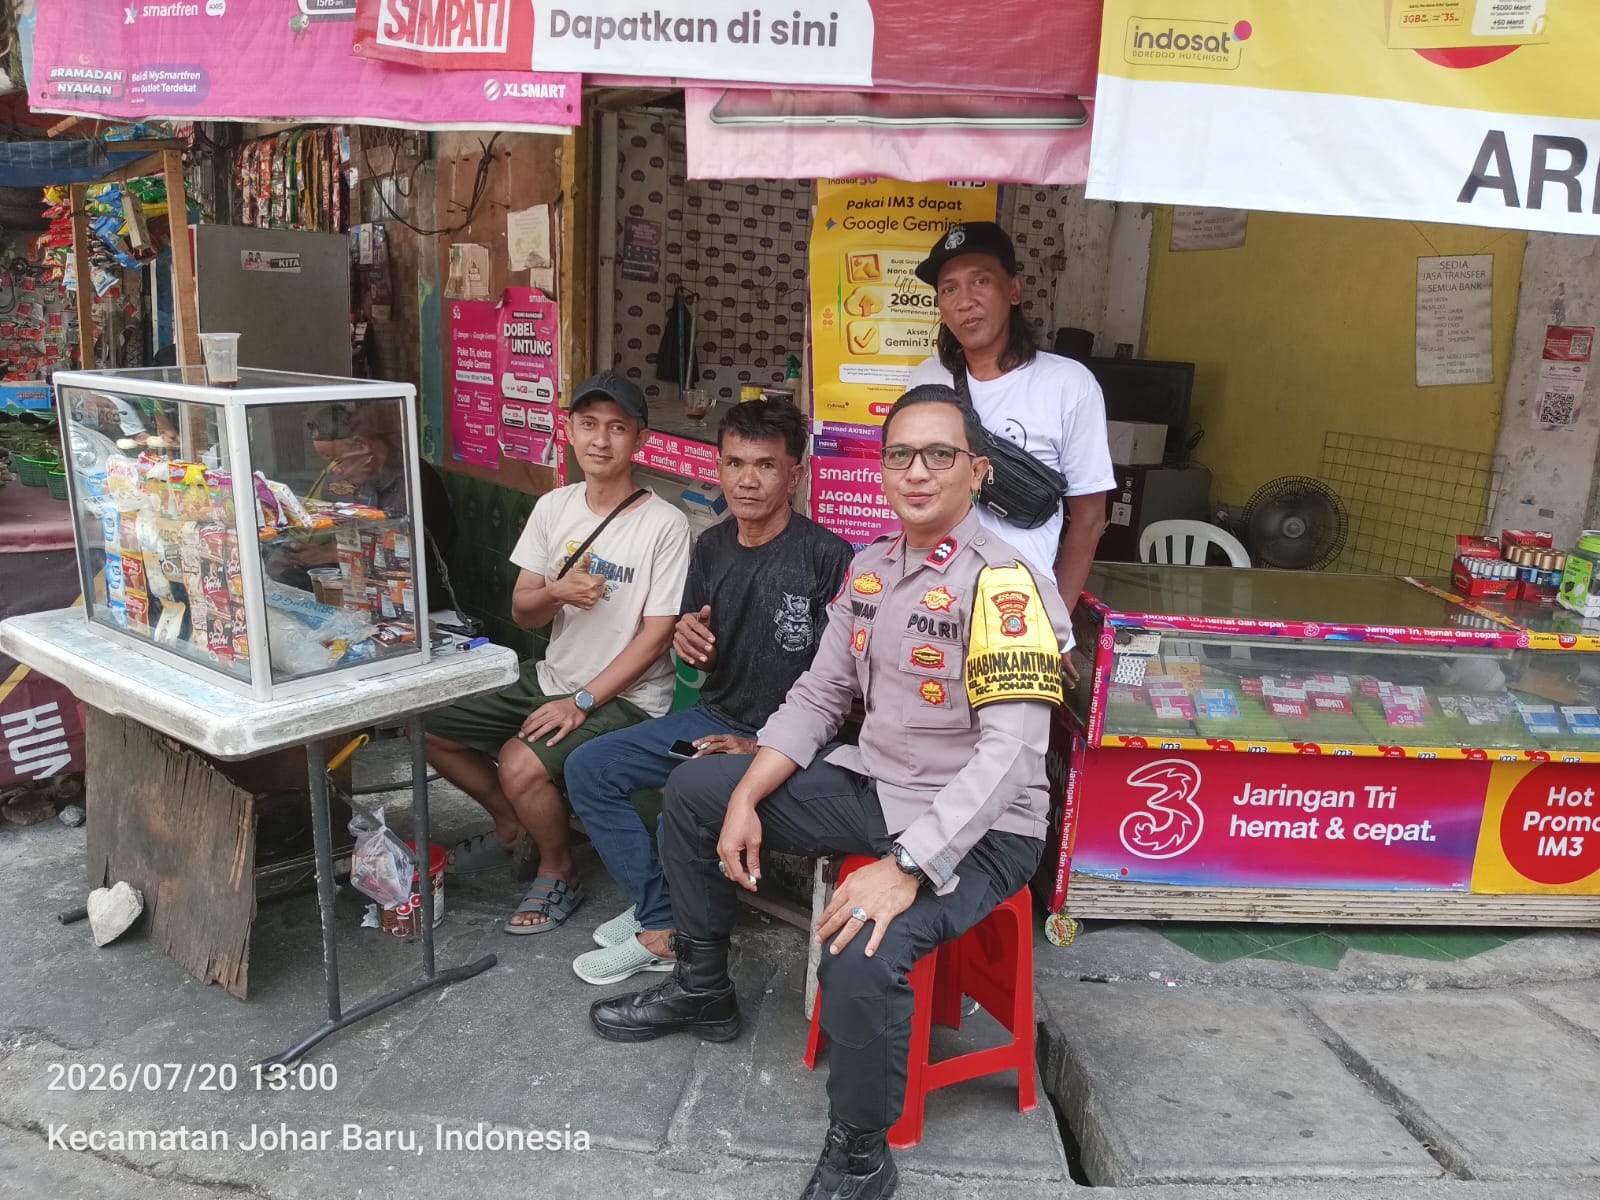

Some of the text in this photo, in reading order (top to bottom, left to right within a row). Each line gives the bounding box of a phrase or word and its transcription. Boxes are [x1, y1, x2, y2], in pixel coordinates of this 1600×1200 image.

[143, 2, 198, 17] smartfren
[384, 0, 503, 47] SIMPATI
[1402, 14, 1421, 23] 3GB
[550, 9, 839, 50] Dapatkan di sini
[1133, 25, 1231, 54] indosat
[1179, 52, 1229, 63] HUTCHISON
[50, 67, 122, 81] #RAMADAN
[57, 83, 112, 95] NYAMAN
[162, 83, 197, 93] Terdekat
[502, 83, 566, 99] XLSMART
[1456, 129, 1600, 214] AR
[847, 196, 963, 212] Pakai IM3 dapat
[843, 216, 899, 233] Google
[279, 259, 300, 268] KITA
[1439, 260, 1469, 269] SEDIA
[1422, 270, 1485, 281] JASA TRANSFER
[1427, 282, 1483, 293] SEMUA BANK
[503, 321, 536, 339] DOBEL
[906, 328, 928, 337] Akses
[511, 338, 552, 356] UNTUNG
[884, 338, 922, 347] Gemini
[698, 466, 720, 478] smart
[818, 467, 883, 484] smartfre
[818, 489, 891, 505] JAGOAN SI
[817, 504, 899, 520] SE-INDONES
[817, 516, 882, 529] Bisa Internetan
[844, 528, 870, 537] Kuota
[906, 612, 959, 640] POLRI
[984, 673, 1039, 684] KAMPUNG
[998, 682, 1034, 691] JOHAR
[1039, 683, 1060, 694] BARU
[1273, 702, 1302, 715] SIMPATI
[1315, 698, 1344, 710] SIMPATI
[1066, 768, 1077, 805] Jaringan
[1233, 782, 1397, 813] Jaringan Tri
[1546, 786, 1595, 807] Hot
[1229, 814, 1436, 845] hemat & cepat.
[1522, 811, 1600, 832] Promo
[1061, 823, 1072, 849] hemat
[1537, 836, 1585, 857] IM3
[1059, 851, 1068, 867] dan
[1055, 869, 1065, 894] cepat.
